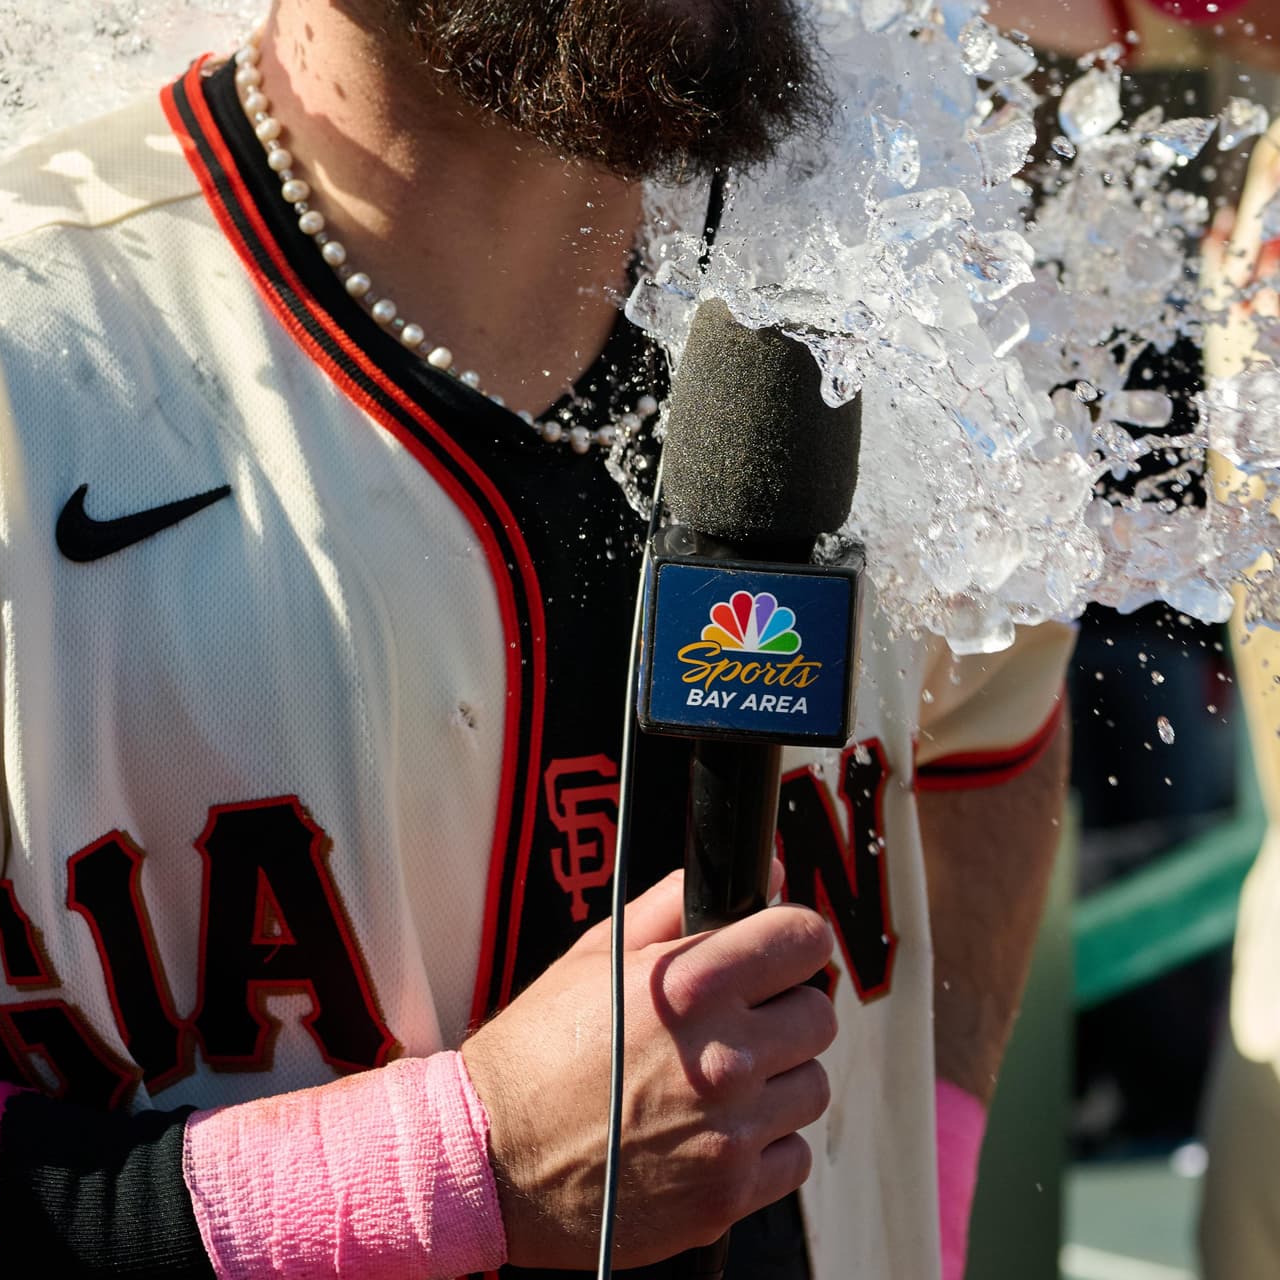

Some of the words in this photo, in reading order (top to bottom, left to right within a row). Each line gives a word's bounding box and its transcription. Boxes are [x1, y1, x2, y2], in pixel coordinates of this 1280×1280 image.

[677, 640, 823, 693] Sports
[686, 688, 737, 709] BAY
[740, 695, 808, 714] AREA
